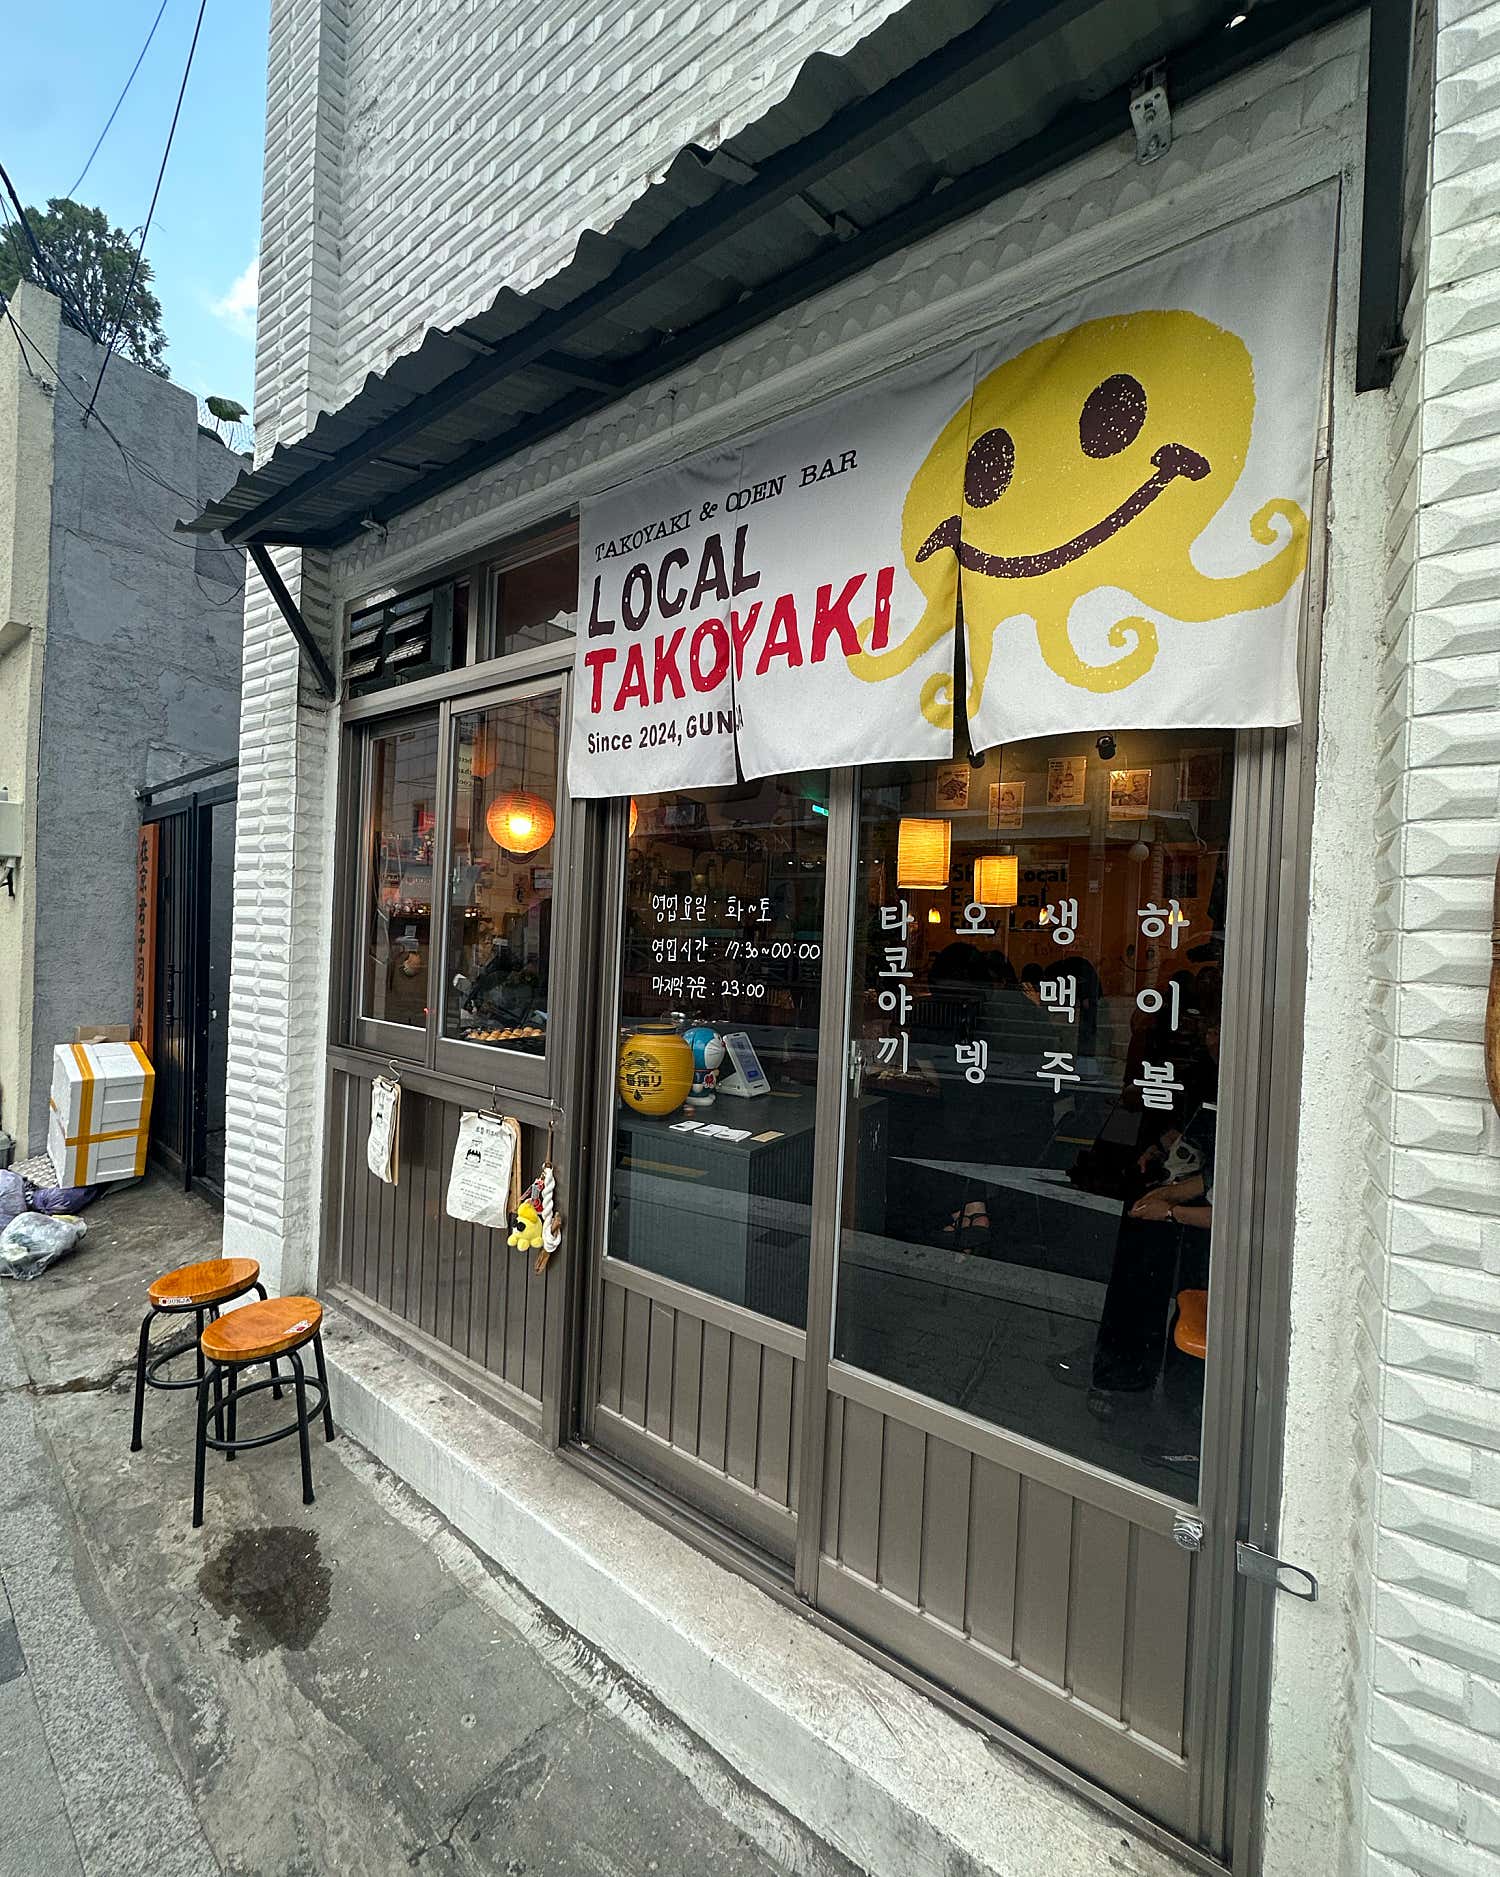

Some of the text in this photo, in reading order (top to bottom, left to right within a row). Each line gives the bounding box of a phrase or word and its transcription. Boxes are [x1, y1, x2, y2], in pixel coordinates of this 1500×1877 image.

[594, 449, 858, 562] TAKOYAKI & ODEN BAR
[584, 566, 896, 714] TAKOYAKI
[587, 523, 761, 638] LOCAL
[587, 730, 633, 755] Since
[721, 979, 764, 998] 23:00
[876, 899, 915, 1074] 타코야끼
[955, 902, 995, 1084] 오뎅
[1036, 898, 1081, 1093] 생맥주
[1133, 899, 1190, 1110] 하이볼
